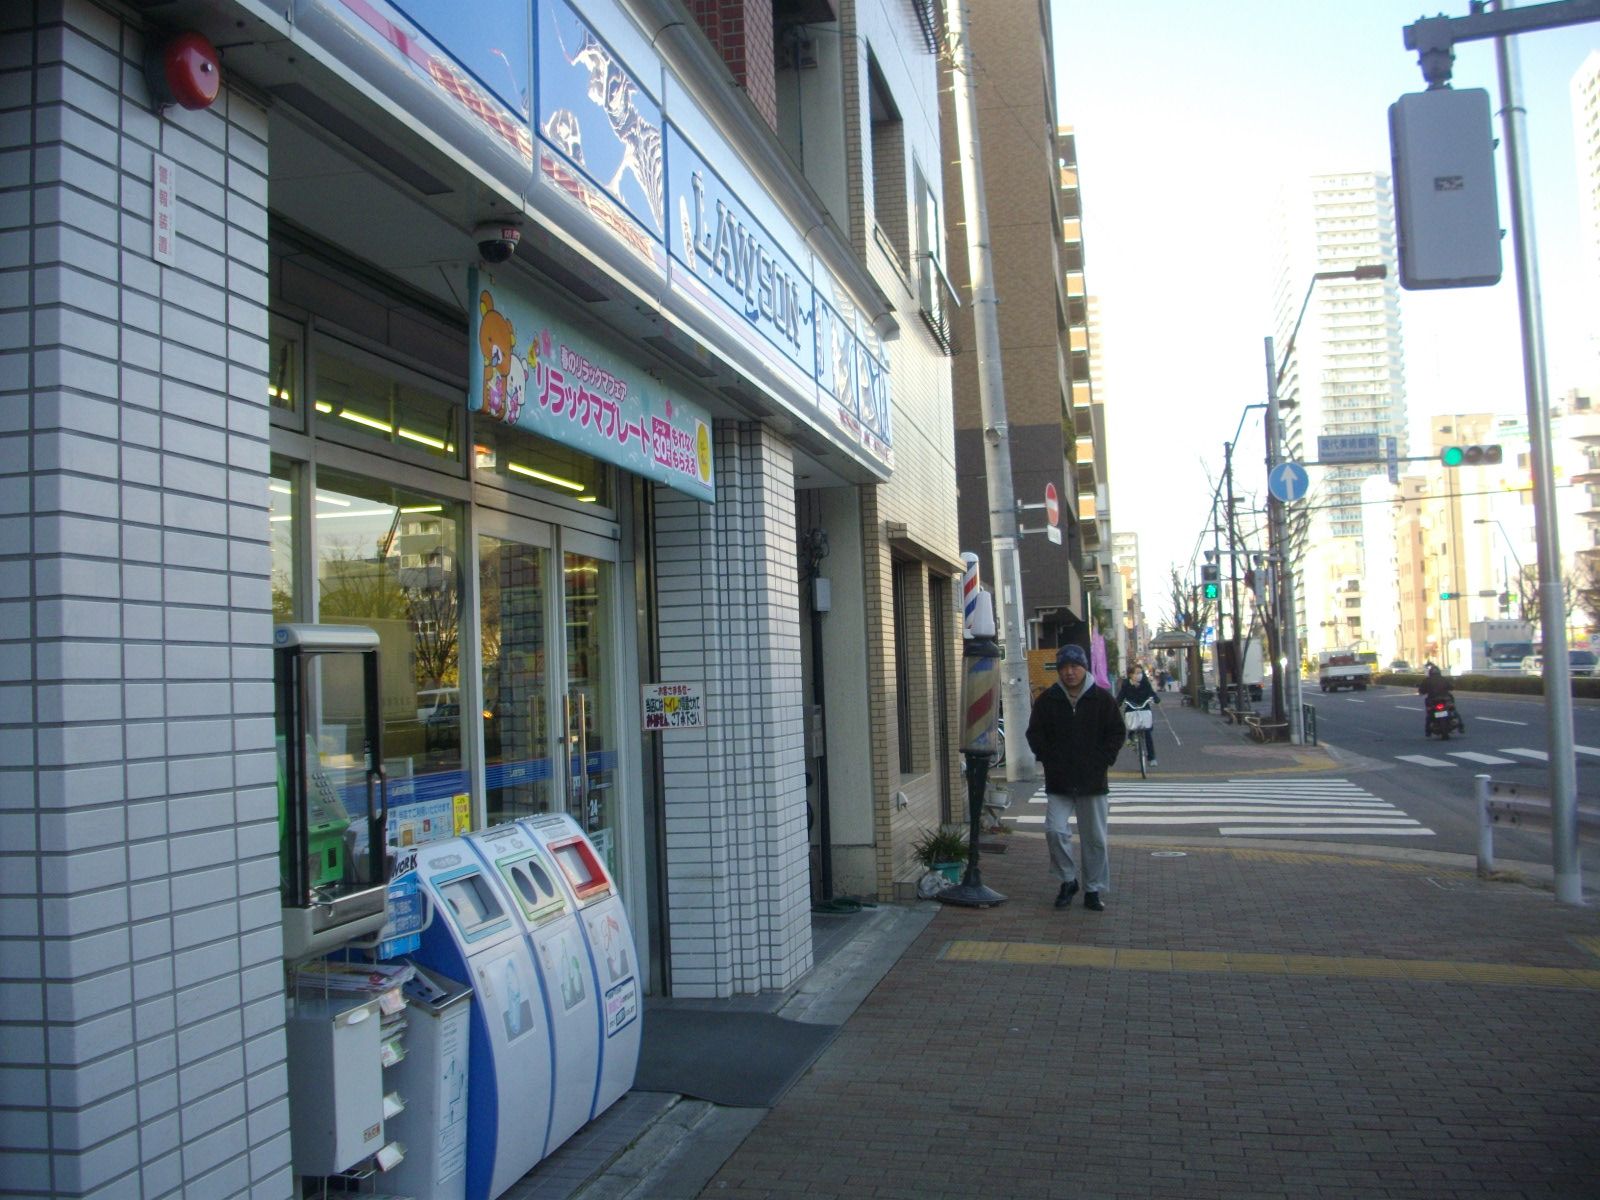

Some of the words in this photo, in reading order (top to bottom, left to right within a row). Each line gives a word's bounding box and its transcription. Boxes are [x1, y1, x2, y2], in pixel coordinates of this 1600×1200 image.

[691, 171, 801, 350] LAWSON
[536, 360, 651, 455] リラックマプレート
[671, 428, 696, 453] もれなく
[672, 449, 697, 477] もらえる
